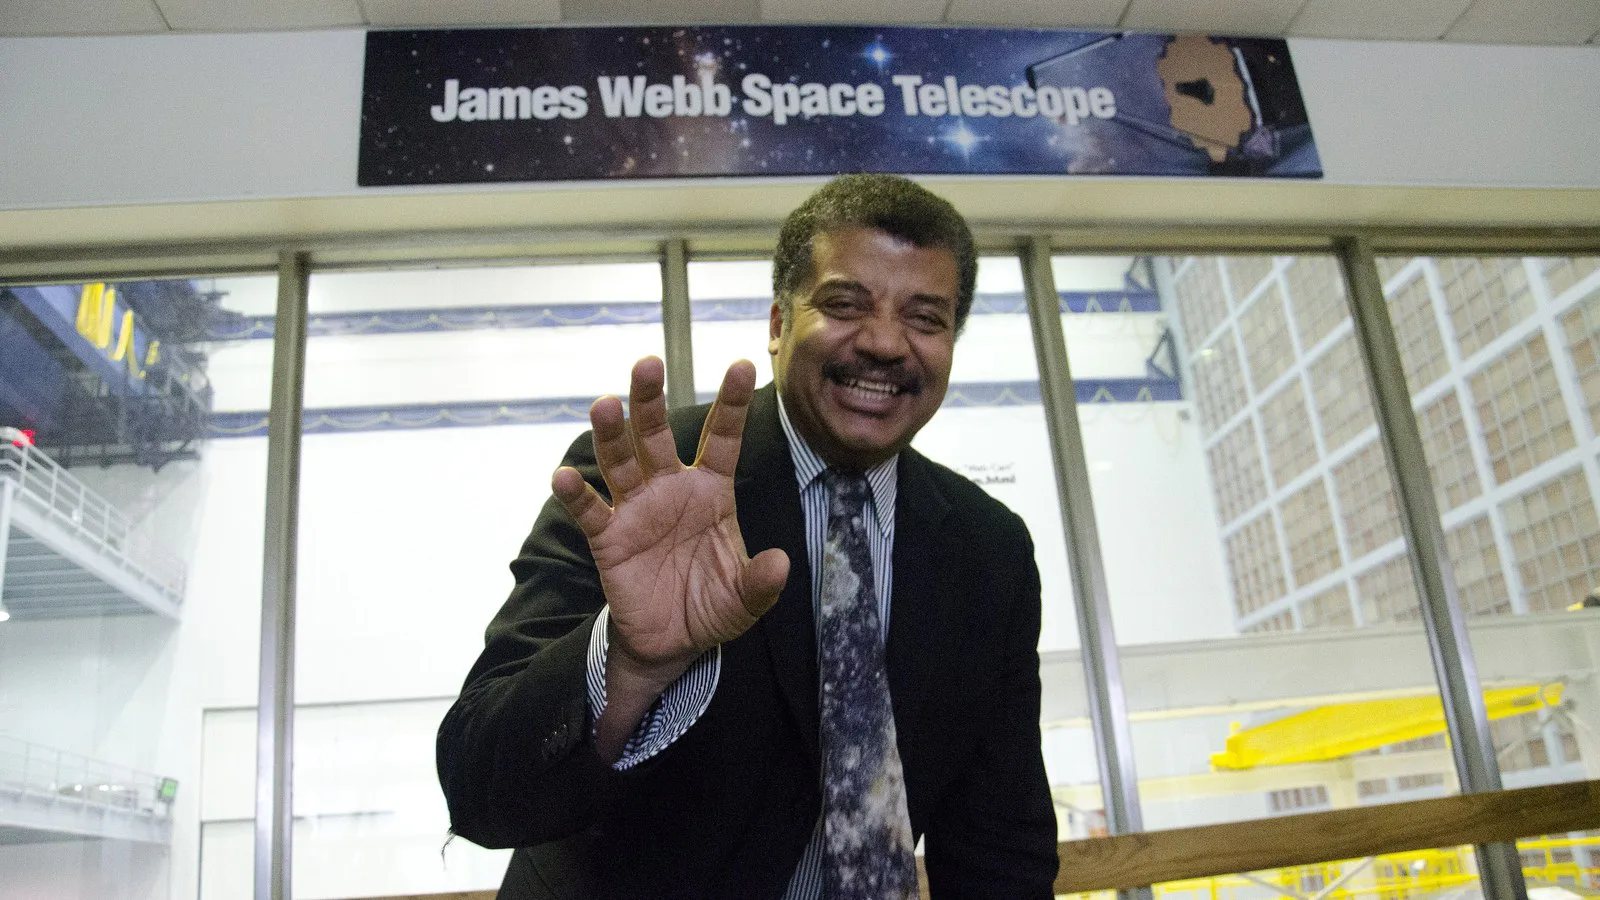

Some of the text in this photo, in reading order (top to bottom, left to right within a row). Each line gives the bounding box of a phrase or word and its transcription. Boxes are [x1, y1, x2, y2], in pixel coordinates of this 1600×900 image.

[430, 73, 1117, 126] James Webb Space Telescope
